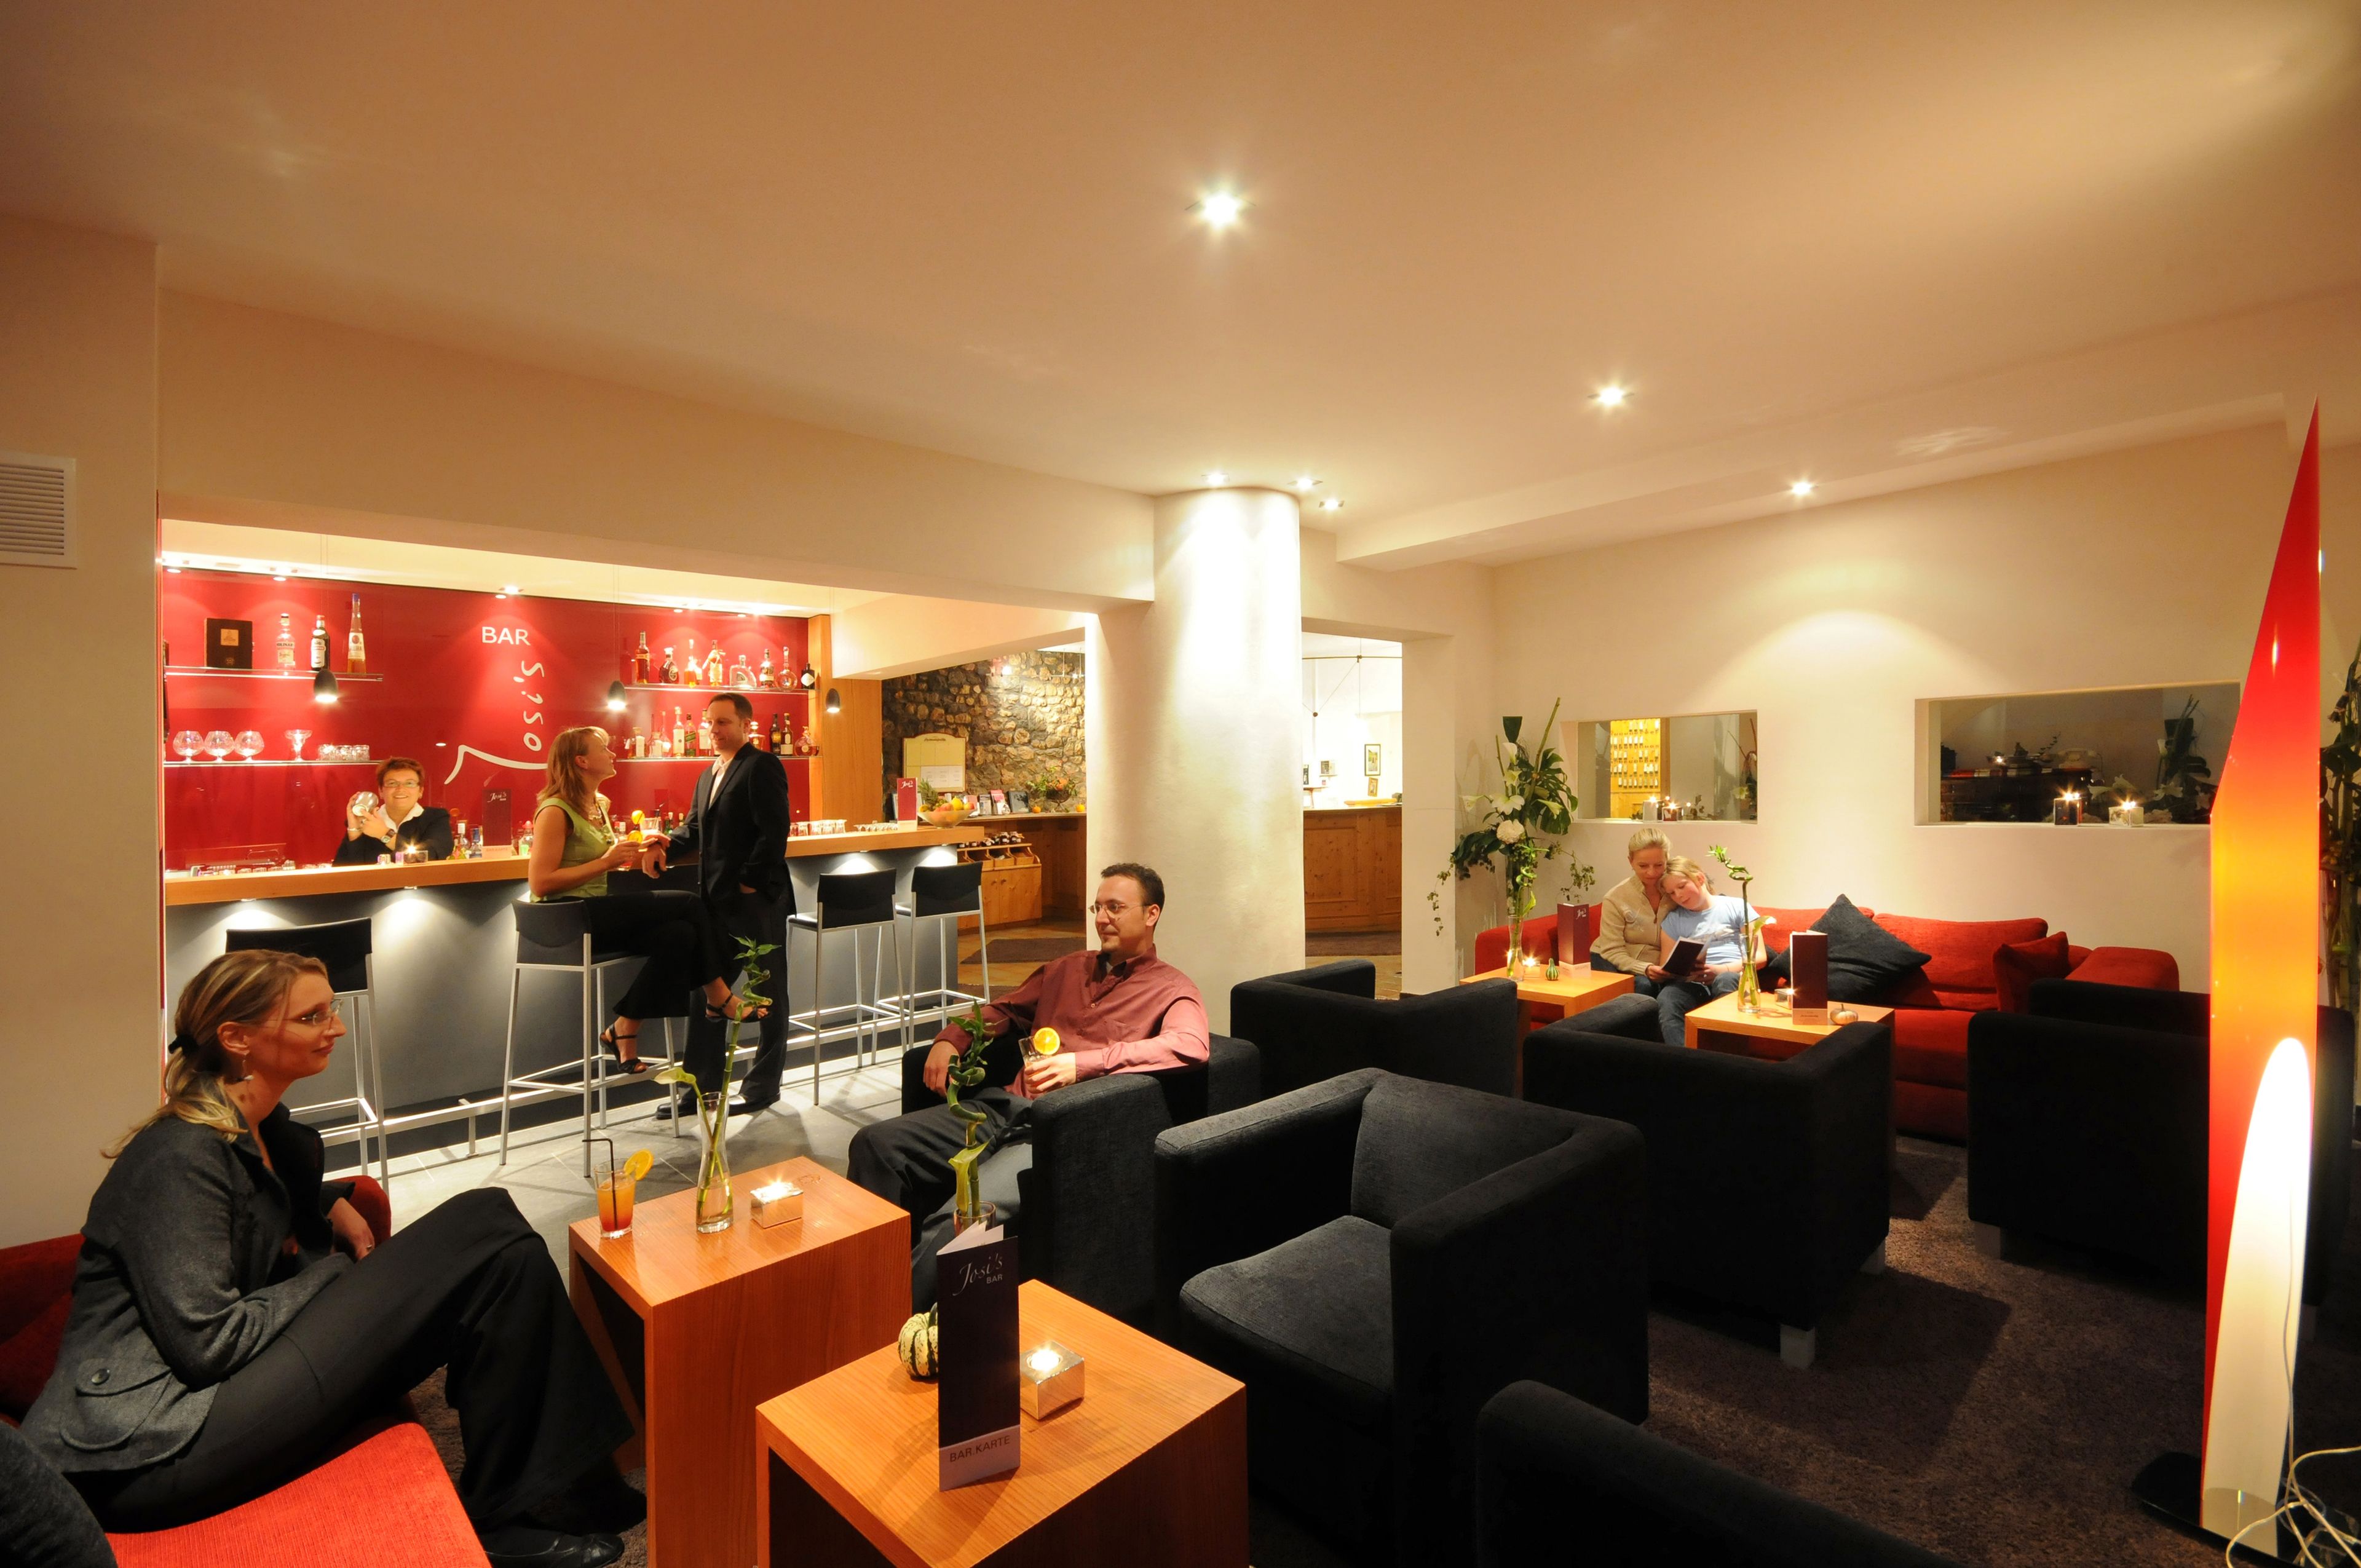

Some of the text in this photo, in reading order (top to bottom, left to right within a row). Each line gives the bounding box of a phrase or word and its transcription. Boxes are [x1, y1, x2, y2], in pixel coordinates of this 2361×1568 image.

[482, 626, 531, 646] BAR
[952, 1253, 1003, 1296] Josi's
[986, 1273, 1003, 1284] BAR
